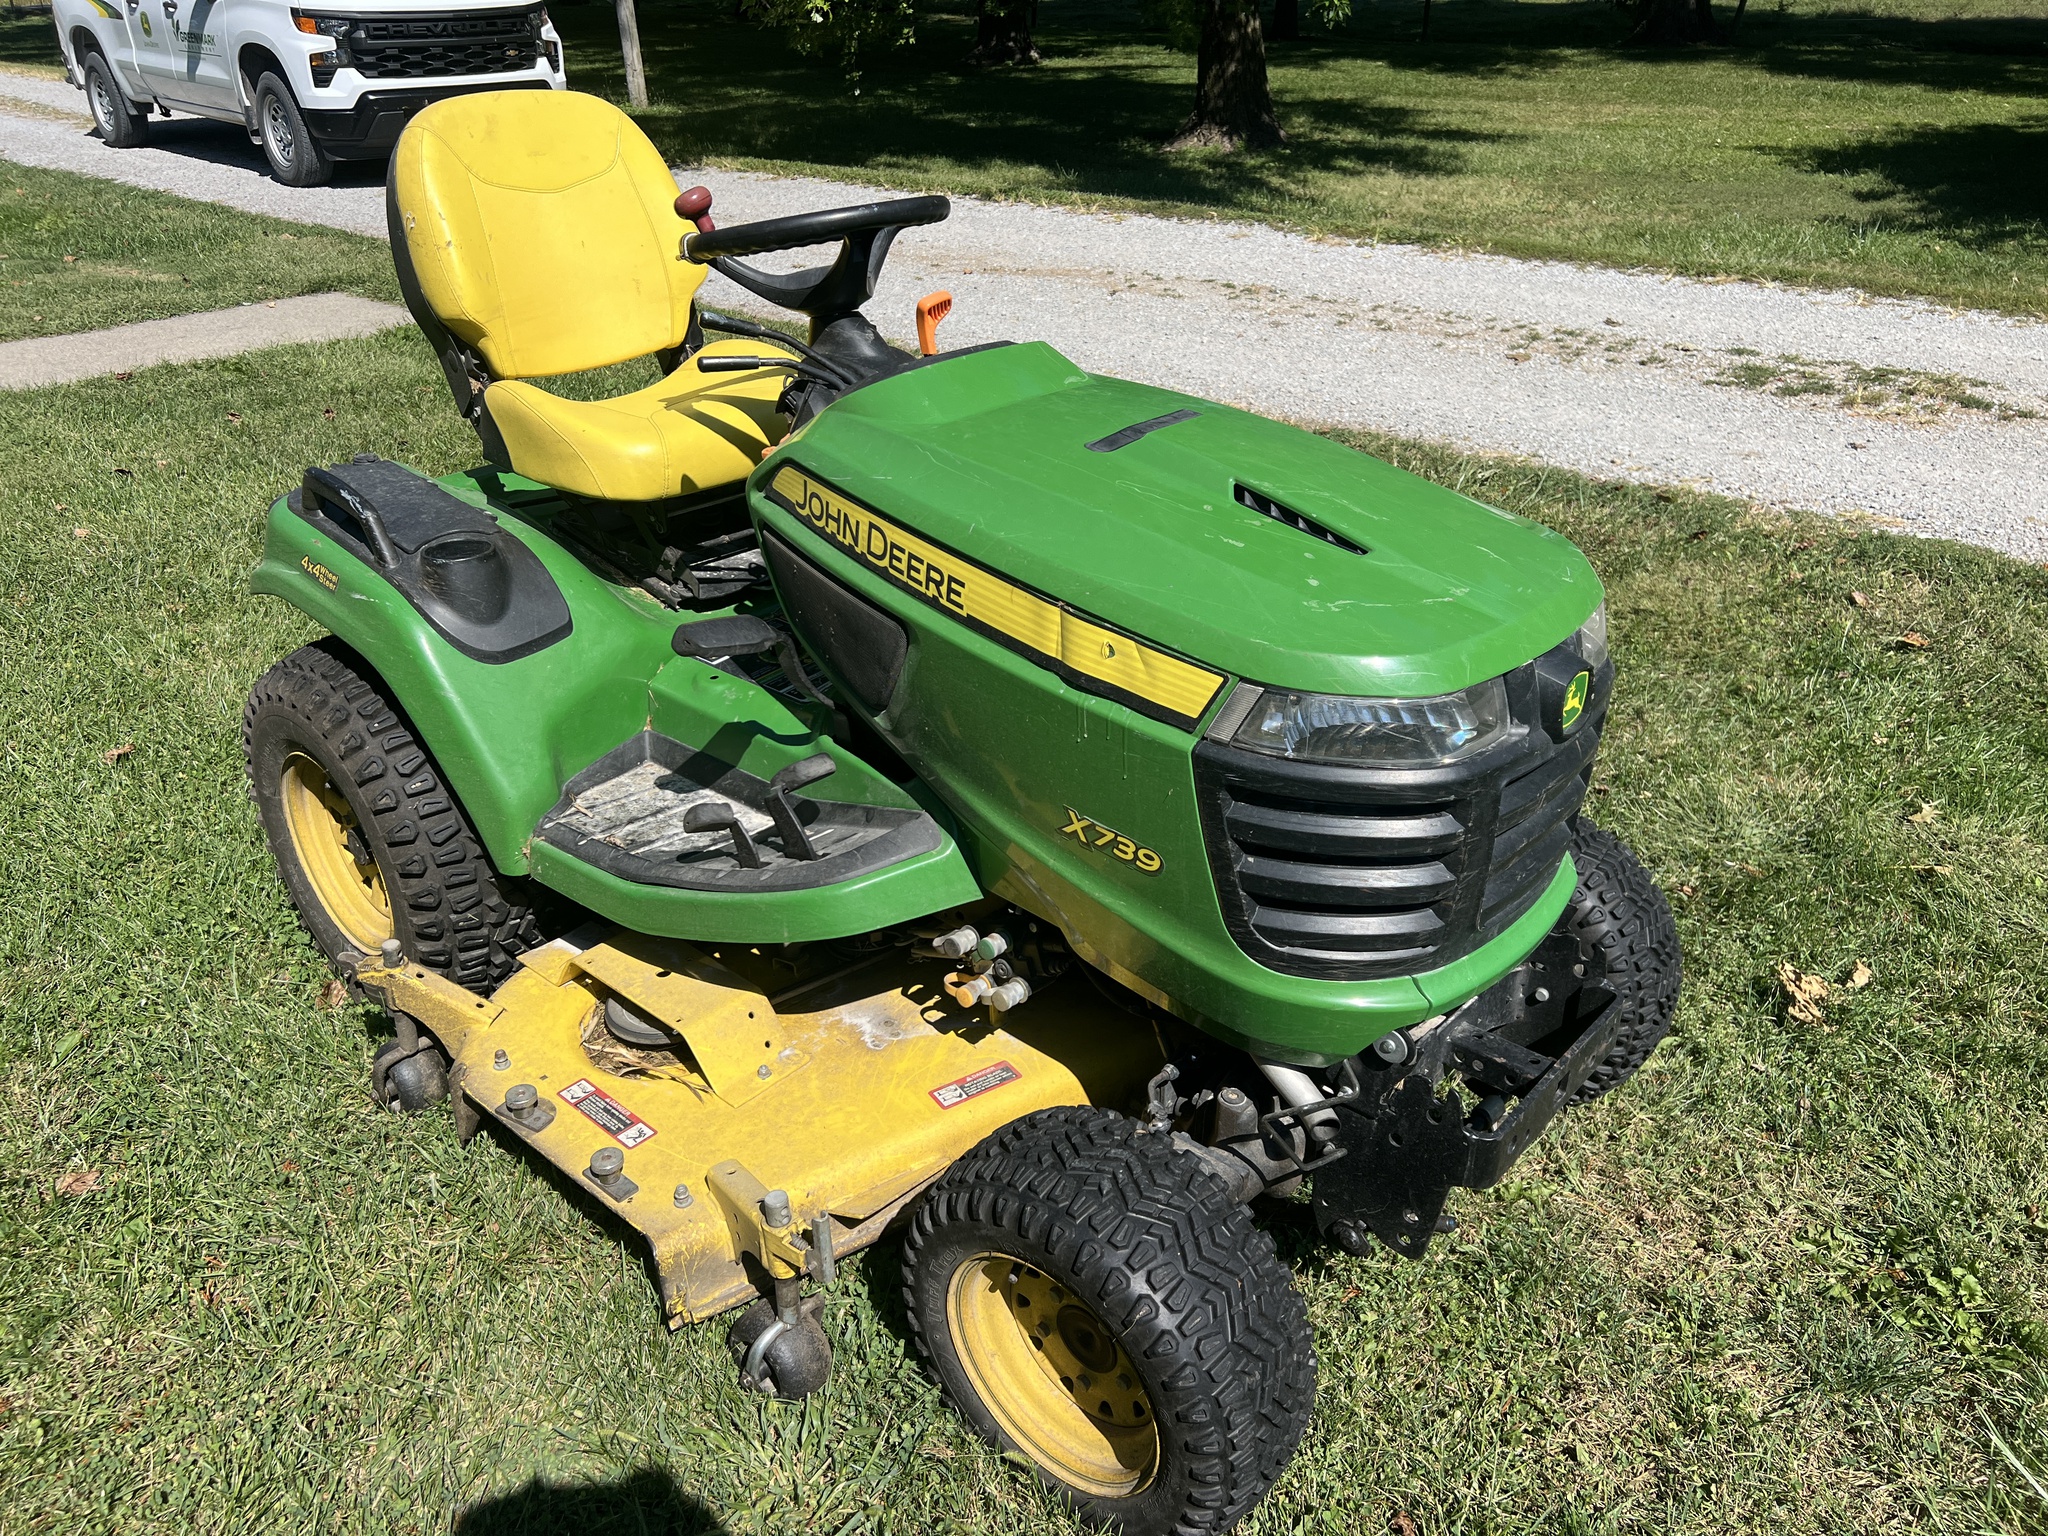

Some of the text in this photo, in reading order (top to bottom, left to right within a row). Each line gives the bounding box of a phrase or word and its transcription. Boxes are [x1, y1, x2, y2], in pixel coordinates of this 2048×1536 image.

[180, 31, 216, 46] GREENMARK
[796, 479, 966, 612] JOHN DEERE
[301, 556, 321, 577] 4x4
[320, 565, 339, 583] Wheel
[319, 574, 336, 590] Steer
[1061, 809, 1161, 872] X739
[972, 1066, 996, 1079] DANGER
[609, 1100, 631, 1116] DANGER
